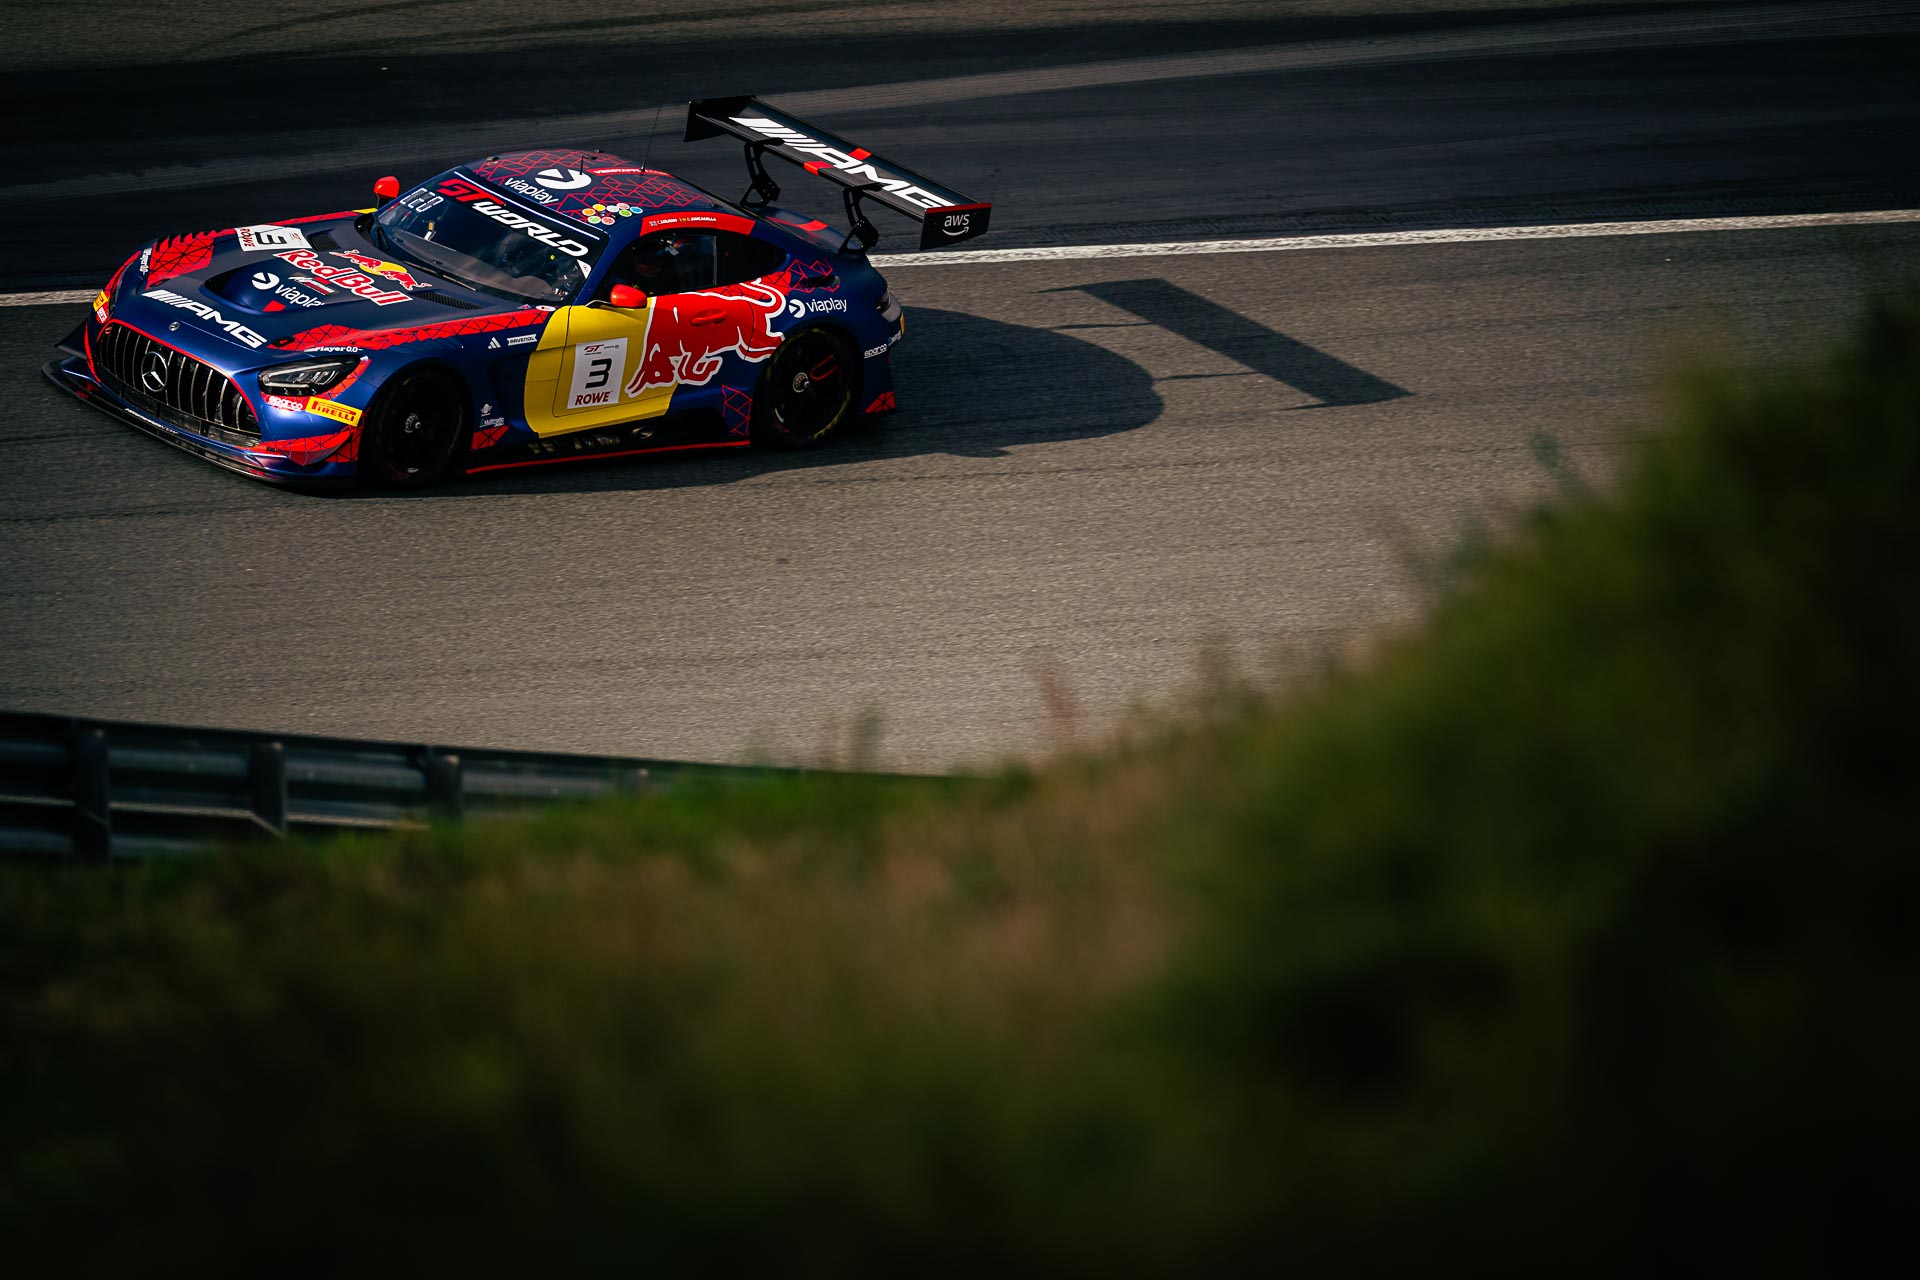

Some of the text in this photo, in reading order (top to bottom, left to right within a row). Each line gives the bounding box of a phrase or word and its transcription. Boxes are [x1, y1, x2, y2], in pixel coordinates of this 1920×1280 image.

[793, 147, 956, 208] AMG
[504, 177, 559, 204] viaplay
[437, 178, 589, 257] GT WORLD
[943, 213, 970, 228] aws
[240, 228, 255, 247] ROWE
[254, 231, 288, 245] 3
[275, 284, 325, 308] viapla
[806, 298, 848, 313] viaplay
[175, 302, 268, 349] AMG
[509, 336, 536, 344] RAVENOL
[864, 343, 888, 359] sparco
[585, 358, 613, 389] 3
[575, 391, 611, 406] ROWE
[311, 400, 357, 423] PIRELLI
